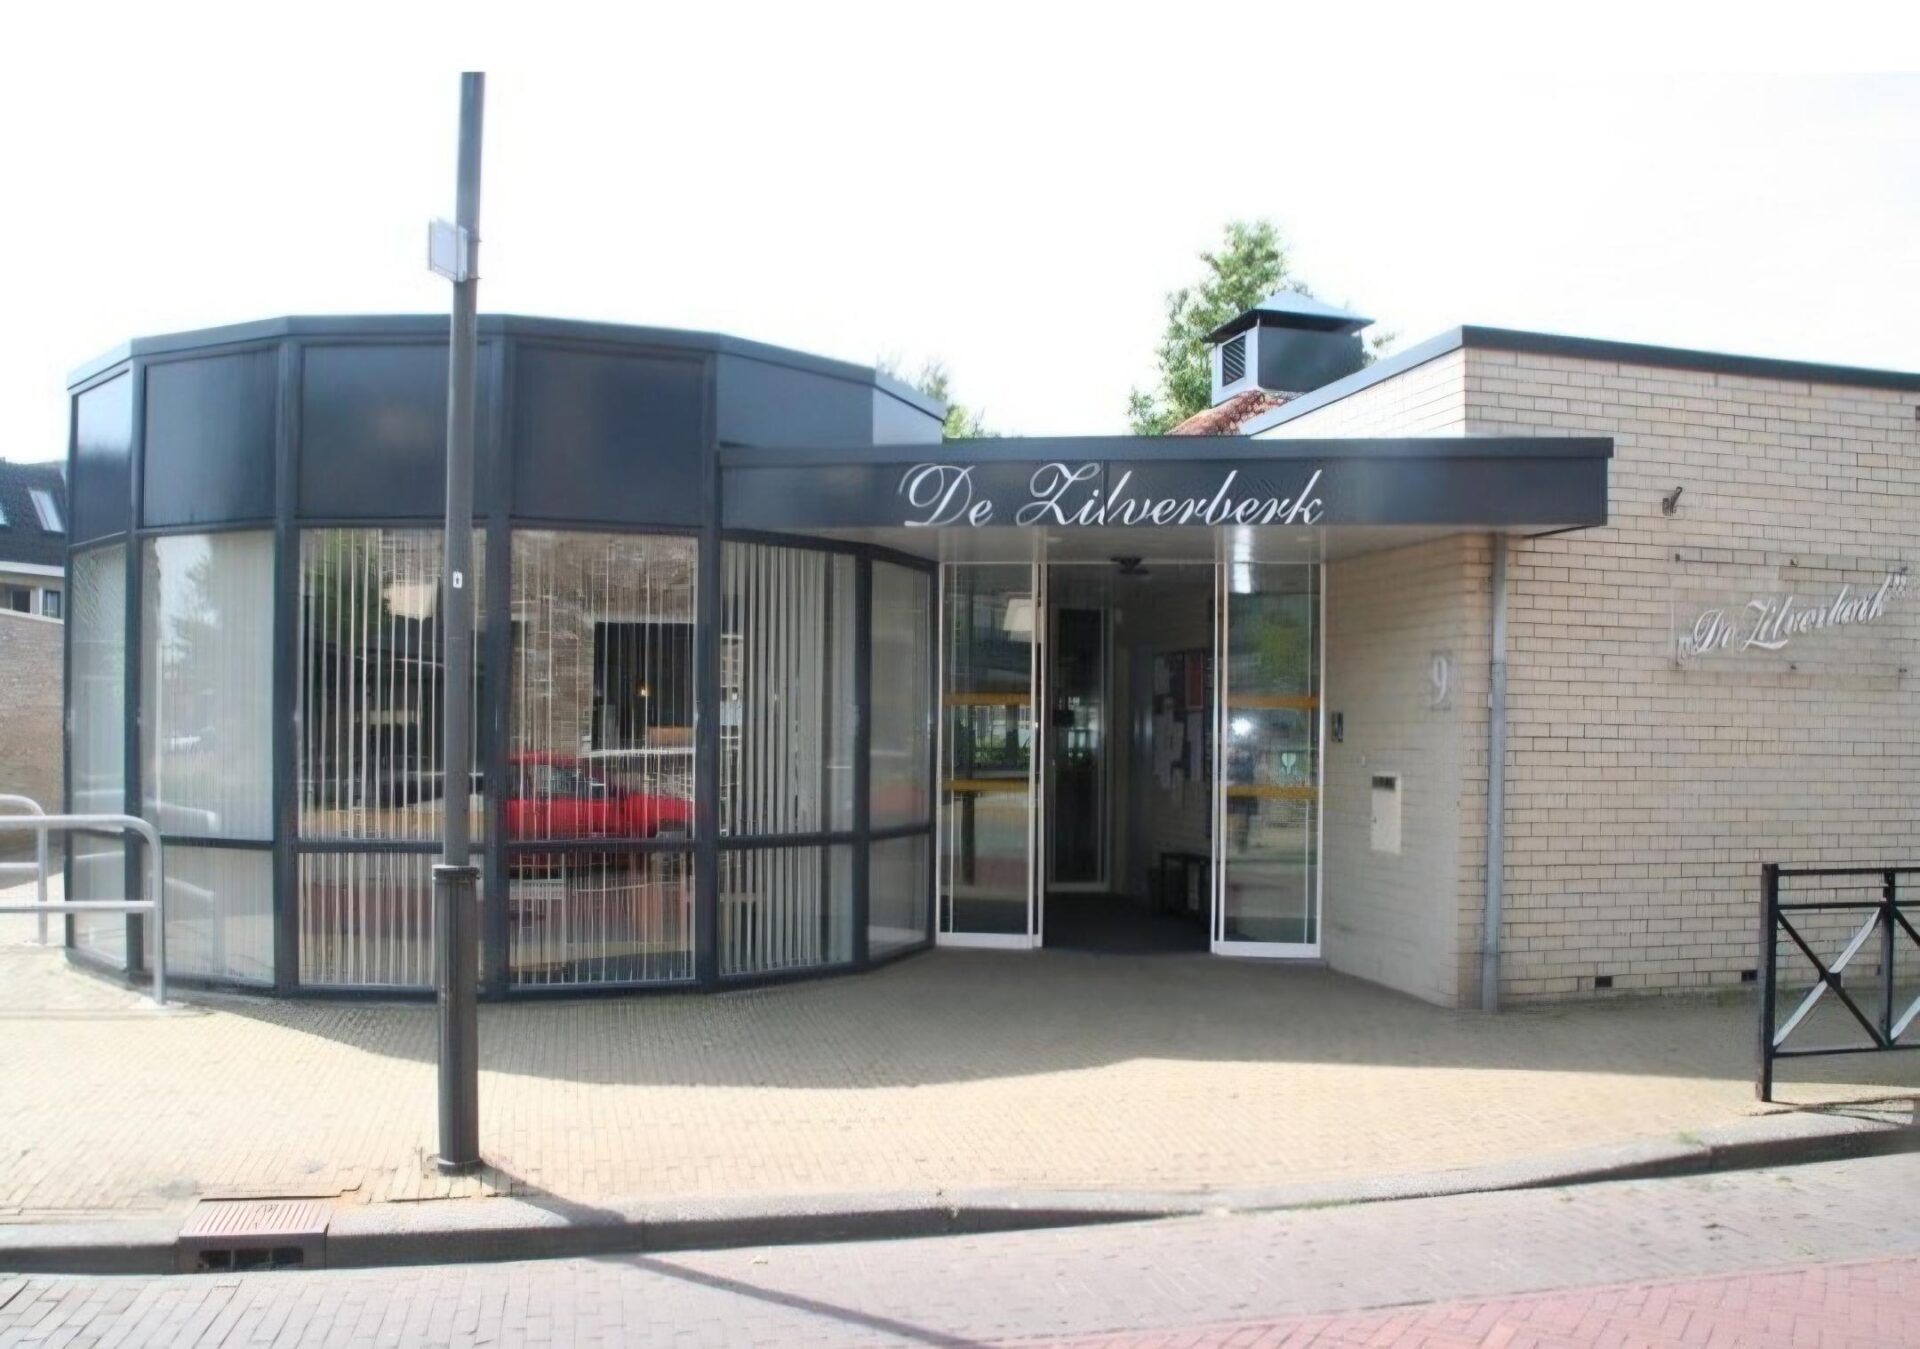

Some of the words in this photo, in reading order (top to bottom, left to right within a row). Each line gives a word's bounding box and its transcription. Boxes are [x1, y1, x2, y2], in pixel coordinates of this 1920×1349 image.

[900, 463, 993, 527] De
[1016, 462, 1324, 527] Zilverberk
[1432, 655, 1448, 704] 9
